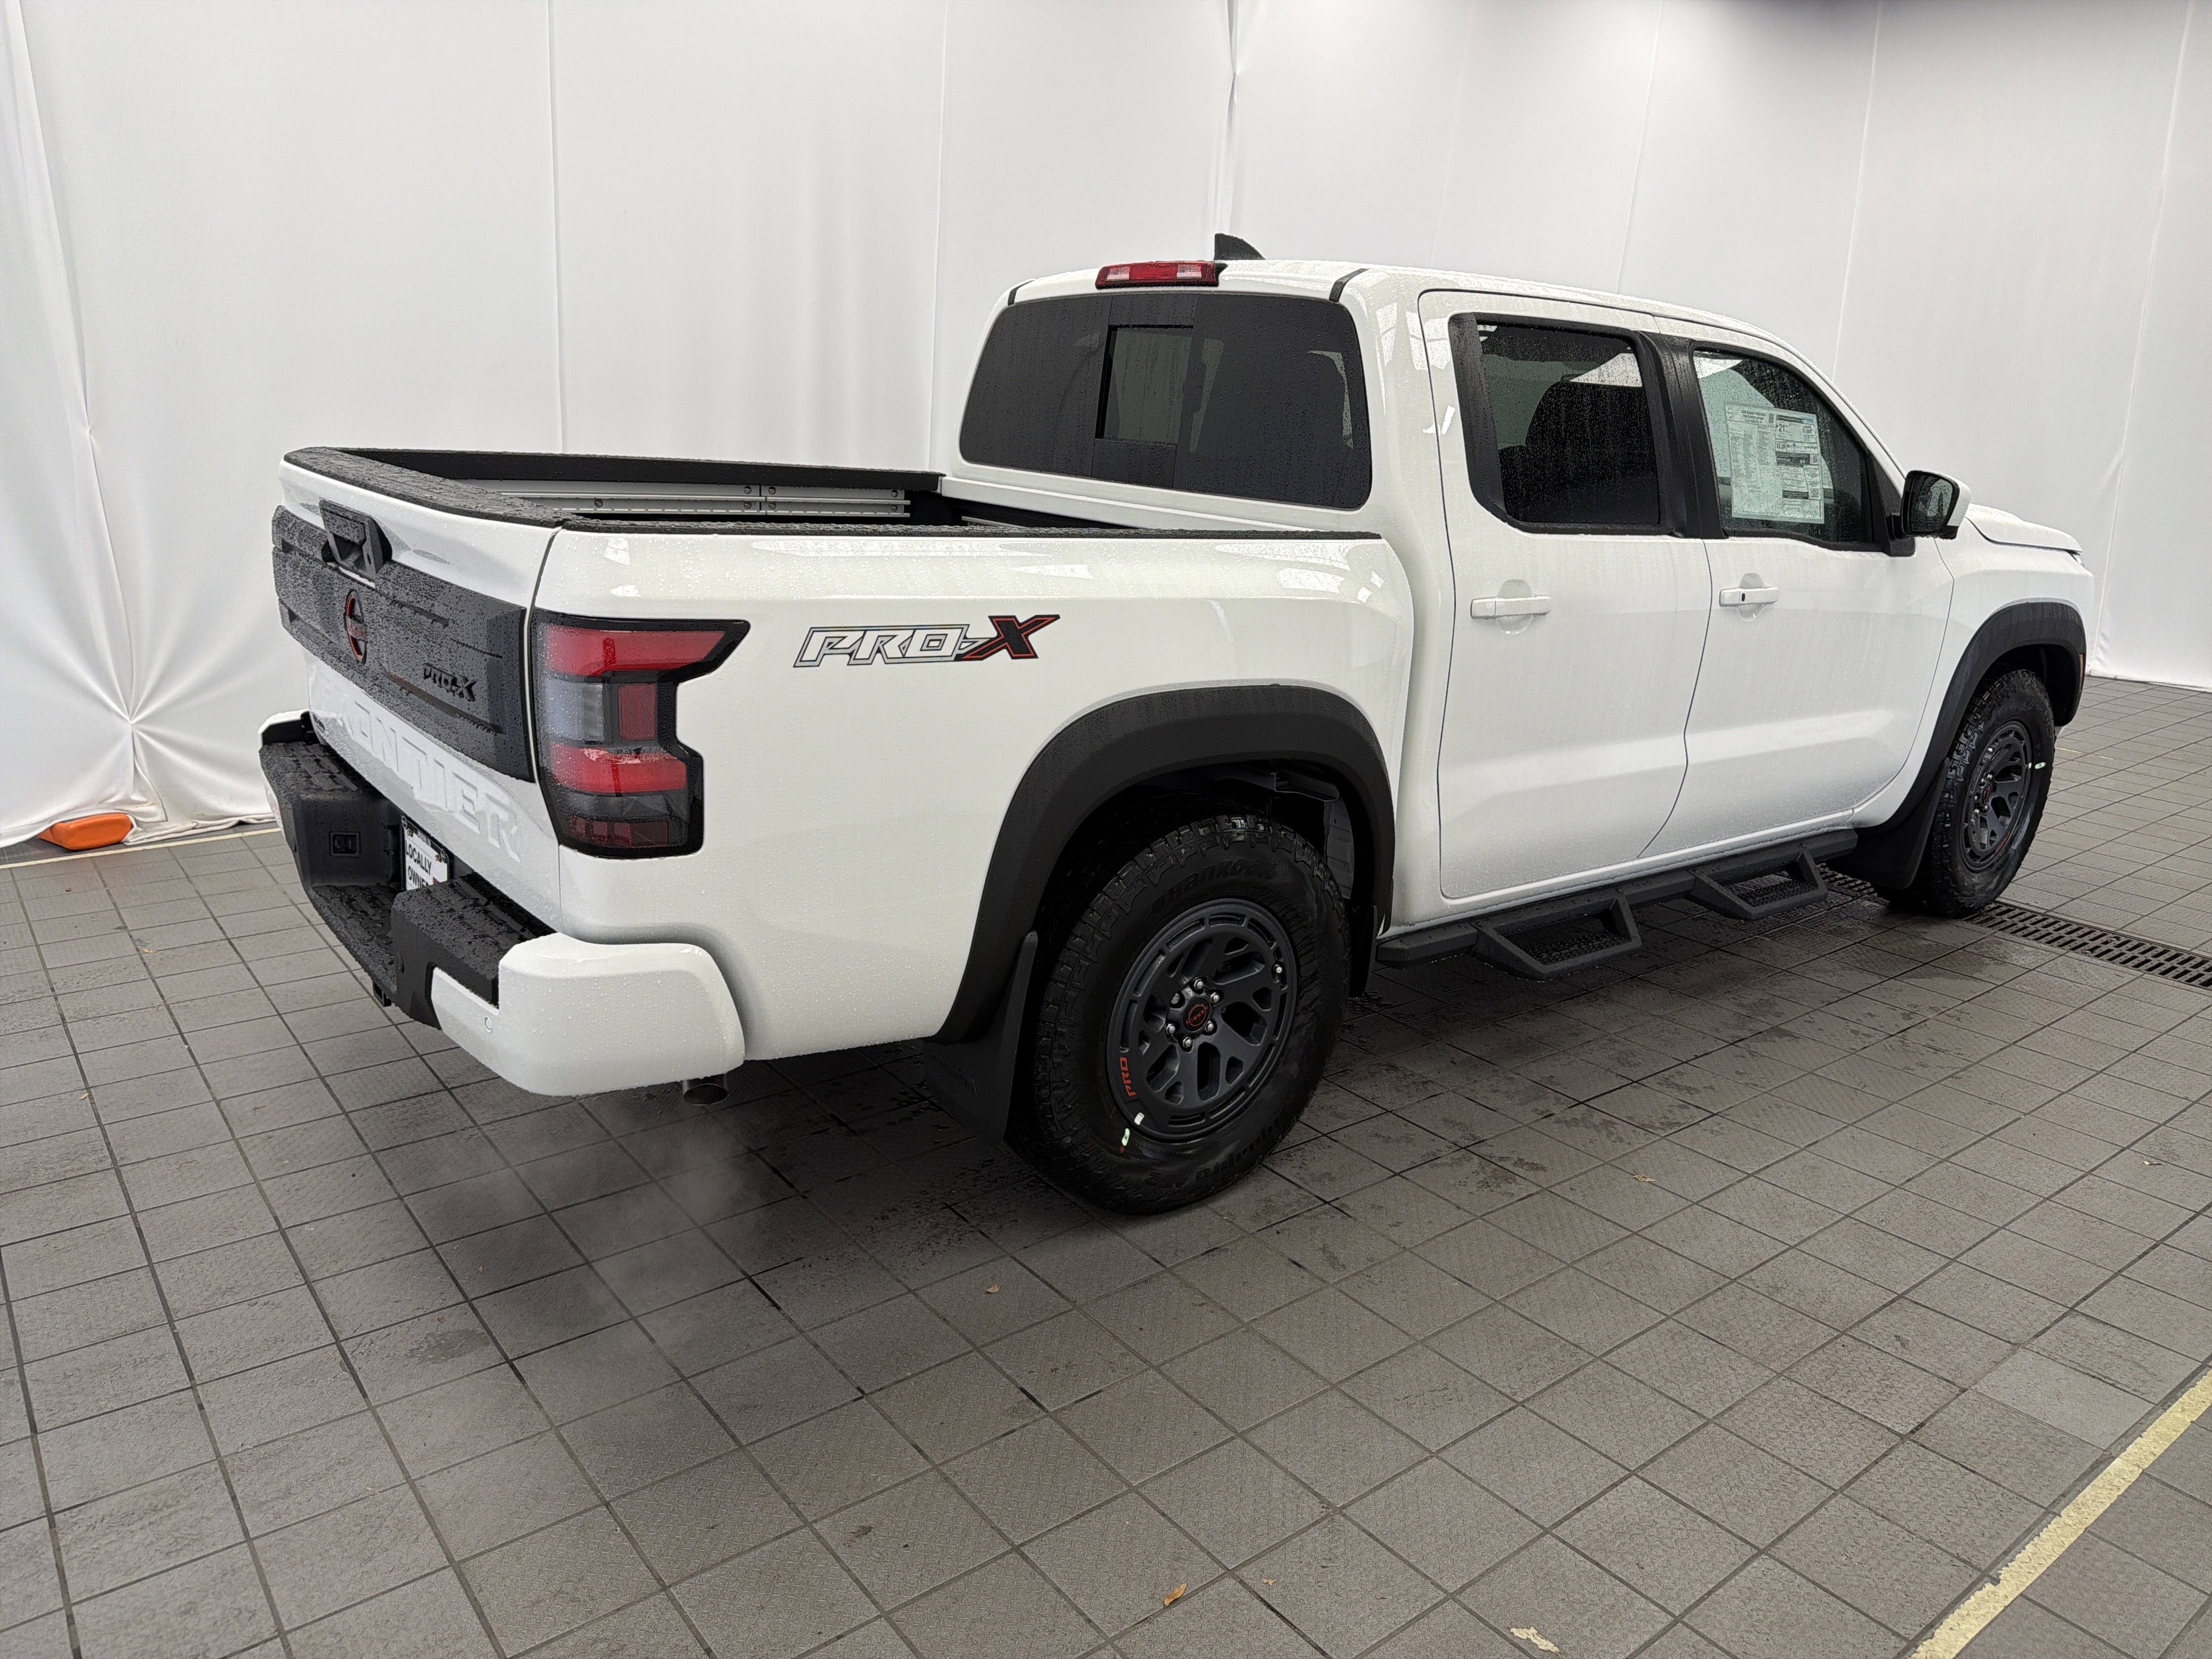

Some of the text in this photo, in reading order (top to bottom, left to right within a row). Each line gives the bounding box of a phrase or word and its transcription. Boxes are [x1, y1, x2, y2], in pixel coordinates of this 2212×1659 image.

[326, 692, 521, 864] ONTIER
[405, 840, 432, 876] LOCALLY
[1119, 1056, 1137, 1097] PRO
